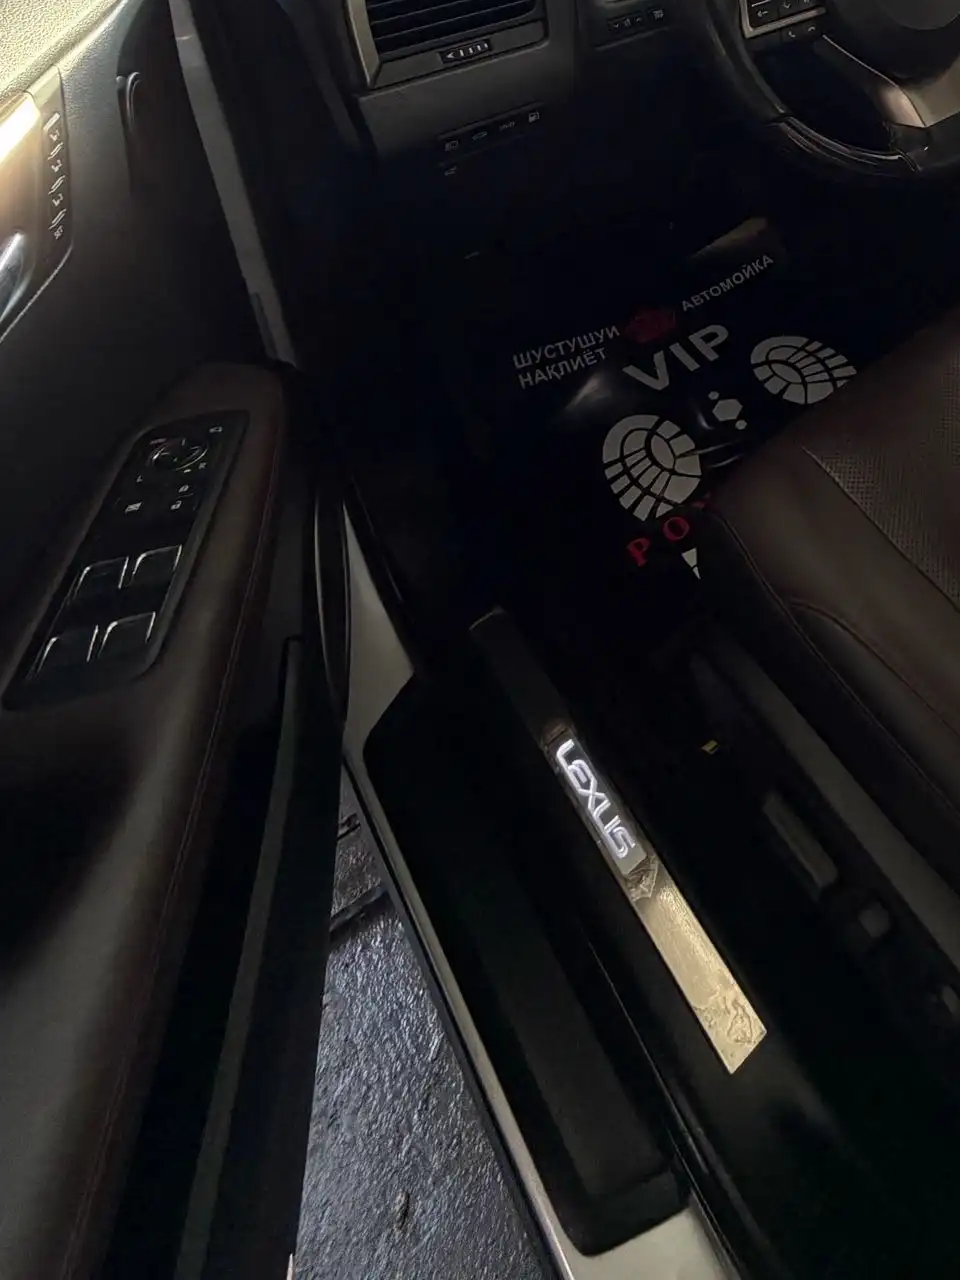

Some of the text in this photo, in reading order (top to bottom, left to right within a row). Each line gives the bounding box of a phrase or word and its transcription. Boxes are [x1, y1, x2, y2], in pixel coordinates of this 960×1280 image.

[681, 253, 774, 312] АВТОМОЙКА
[622, 324, 730, 391] VIP
[557, 738, 635, 859] LEXUS
